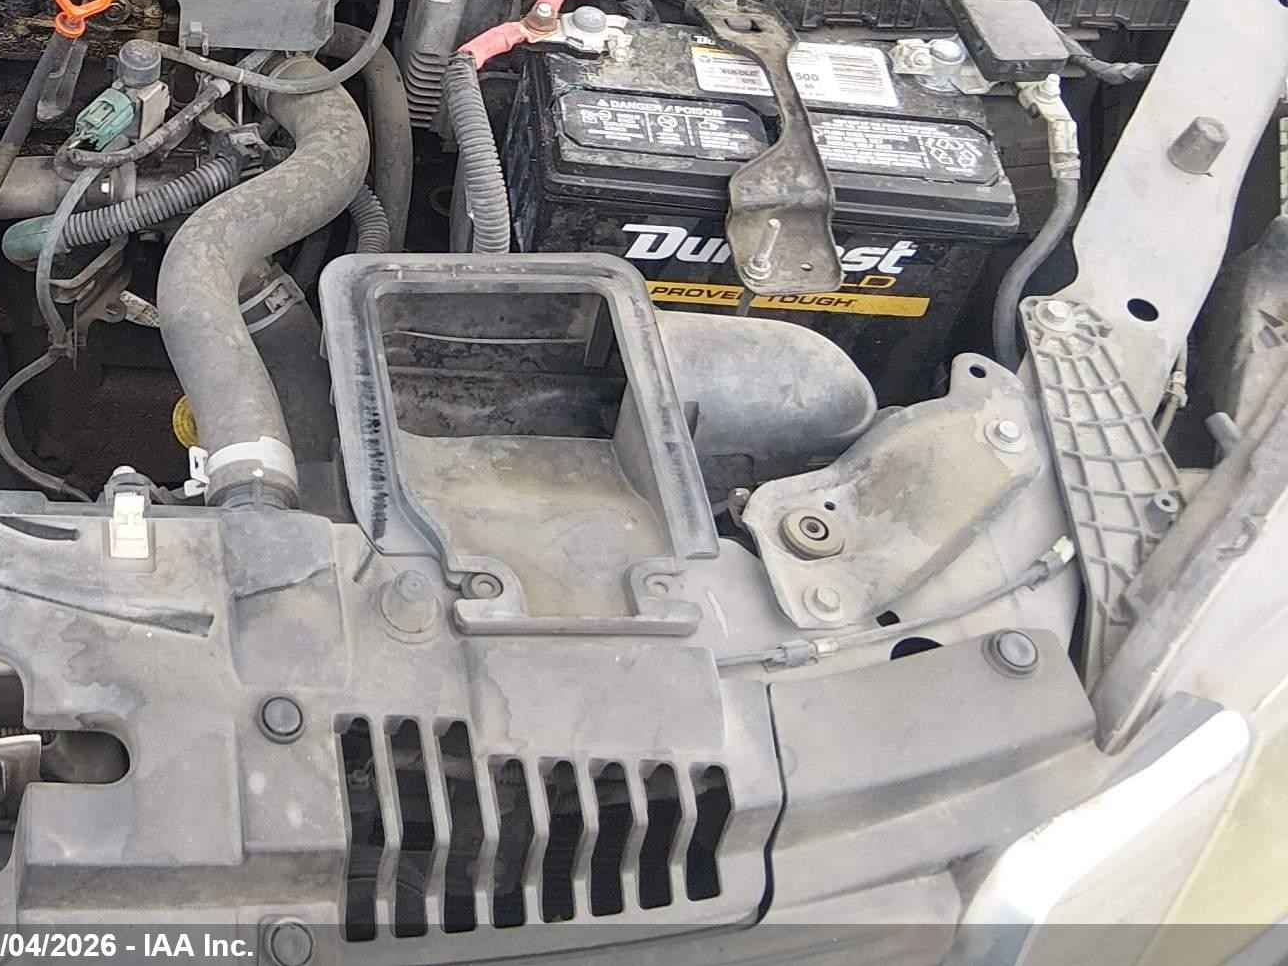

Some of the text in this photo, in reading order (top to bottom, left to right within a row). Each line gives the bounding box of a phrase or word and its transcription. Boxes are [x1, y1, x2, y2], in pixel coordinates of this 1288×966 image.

[795, 71, 820, 83] 500
[609, 100, 661, 113] DANGER
[674, 106, 723, 117] POISON
